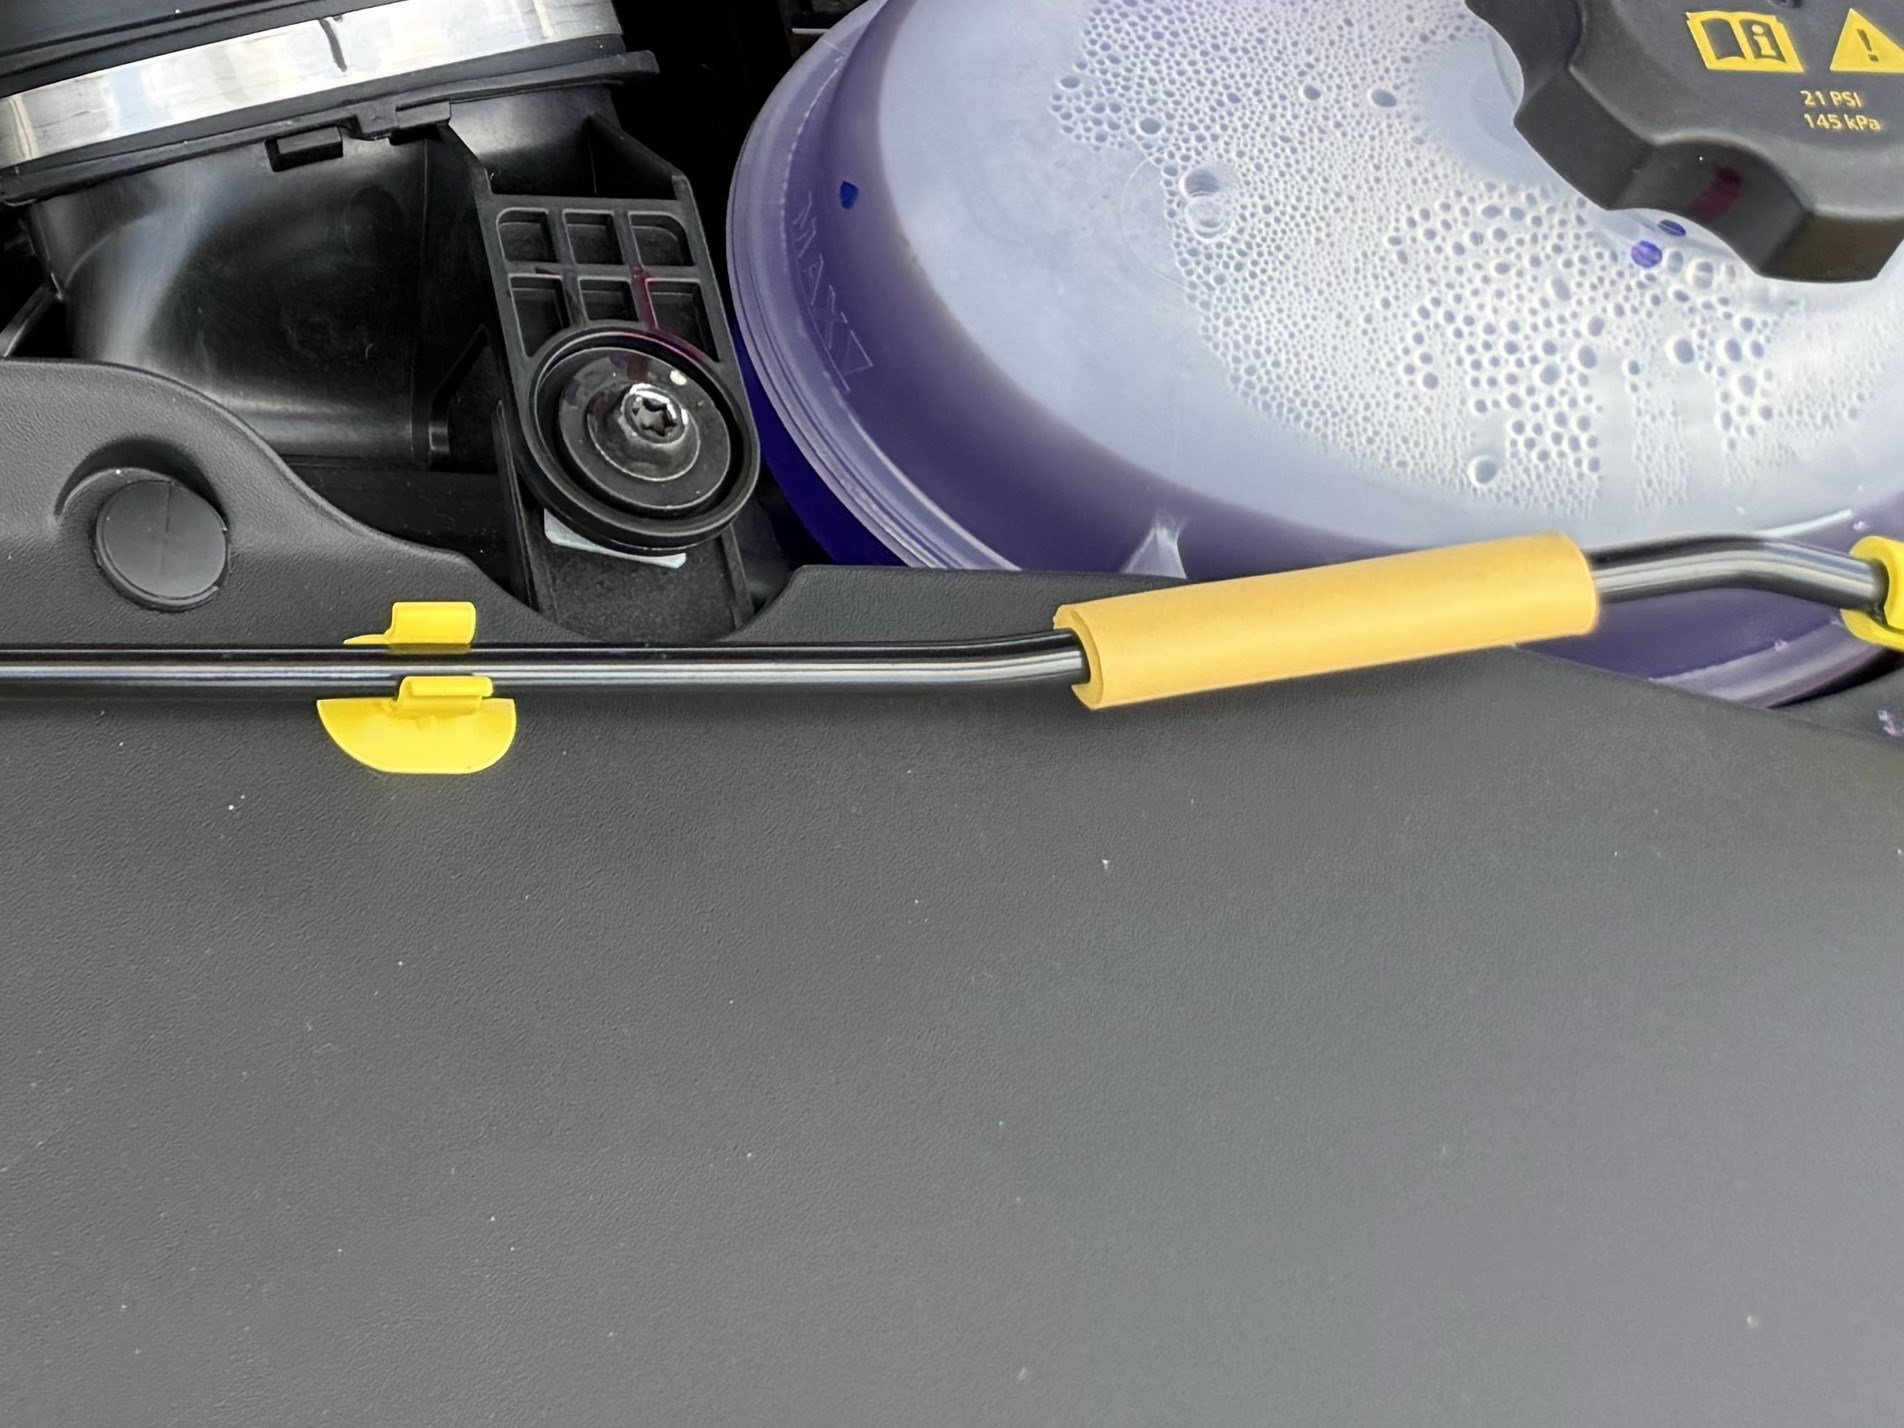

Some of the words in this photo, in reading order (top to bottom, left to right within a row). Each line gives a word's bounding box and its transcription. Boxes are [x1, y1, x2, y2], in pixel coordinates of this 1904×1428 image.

[1800, 89, 1825, 108] 21
[1829, 90, 1862, 109] PSI
[1803, 112, 1838, 131] 145
[1841, 114, 1883, 133] kPa
